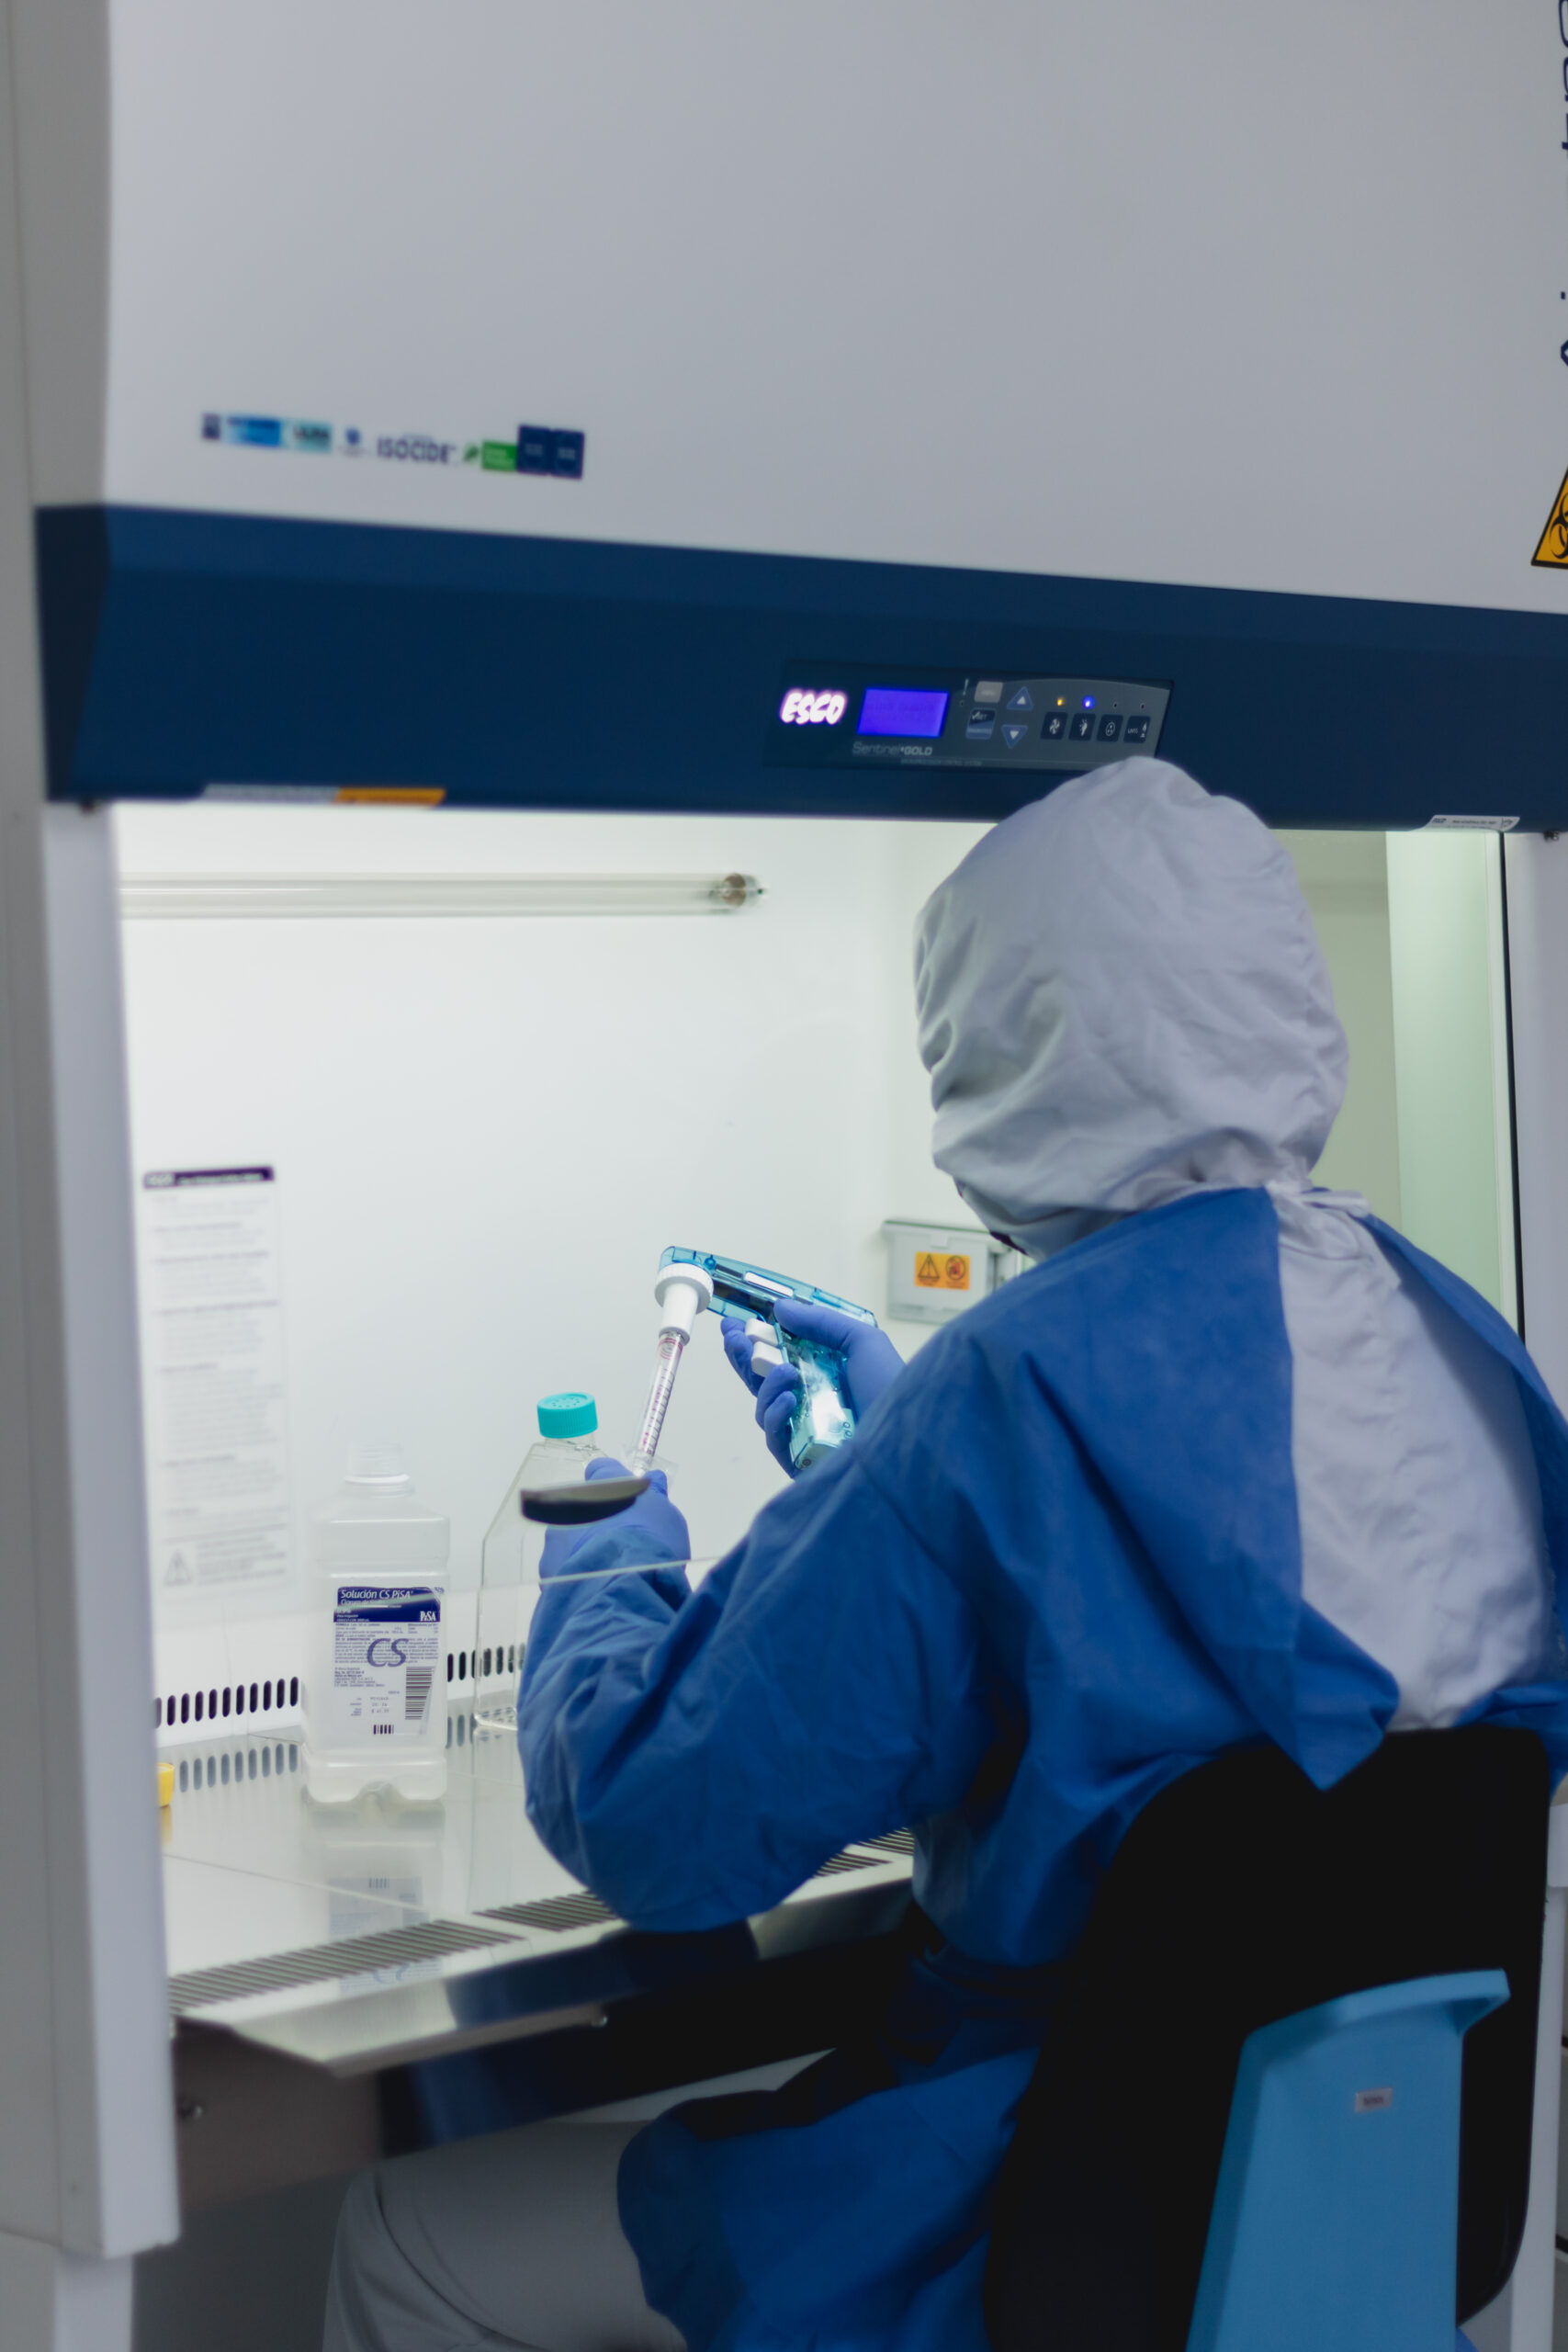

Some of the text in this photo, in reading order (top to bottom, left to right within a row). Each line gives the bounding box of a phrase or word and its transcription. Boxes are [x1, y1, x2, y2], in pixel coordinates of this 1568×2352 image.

[781, 688, 846, 725] ESCO
[904, 745, 933, 756] GOLD
[341, 1589, 377, 1599] Solución
[378, 1589, 390, 1600] CS
[367, 1638, 409, 1668] CS
